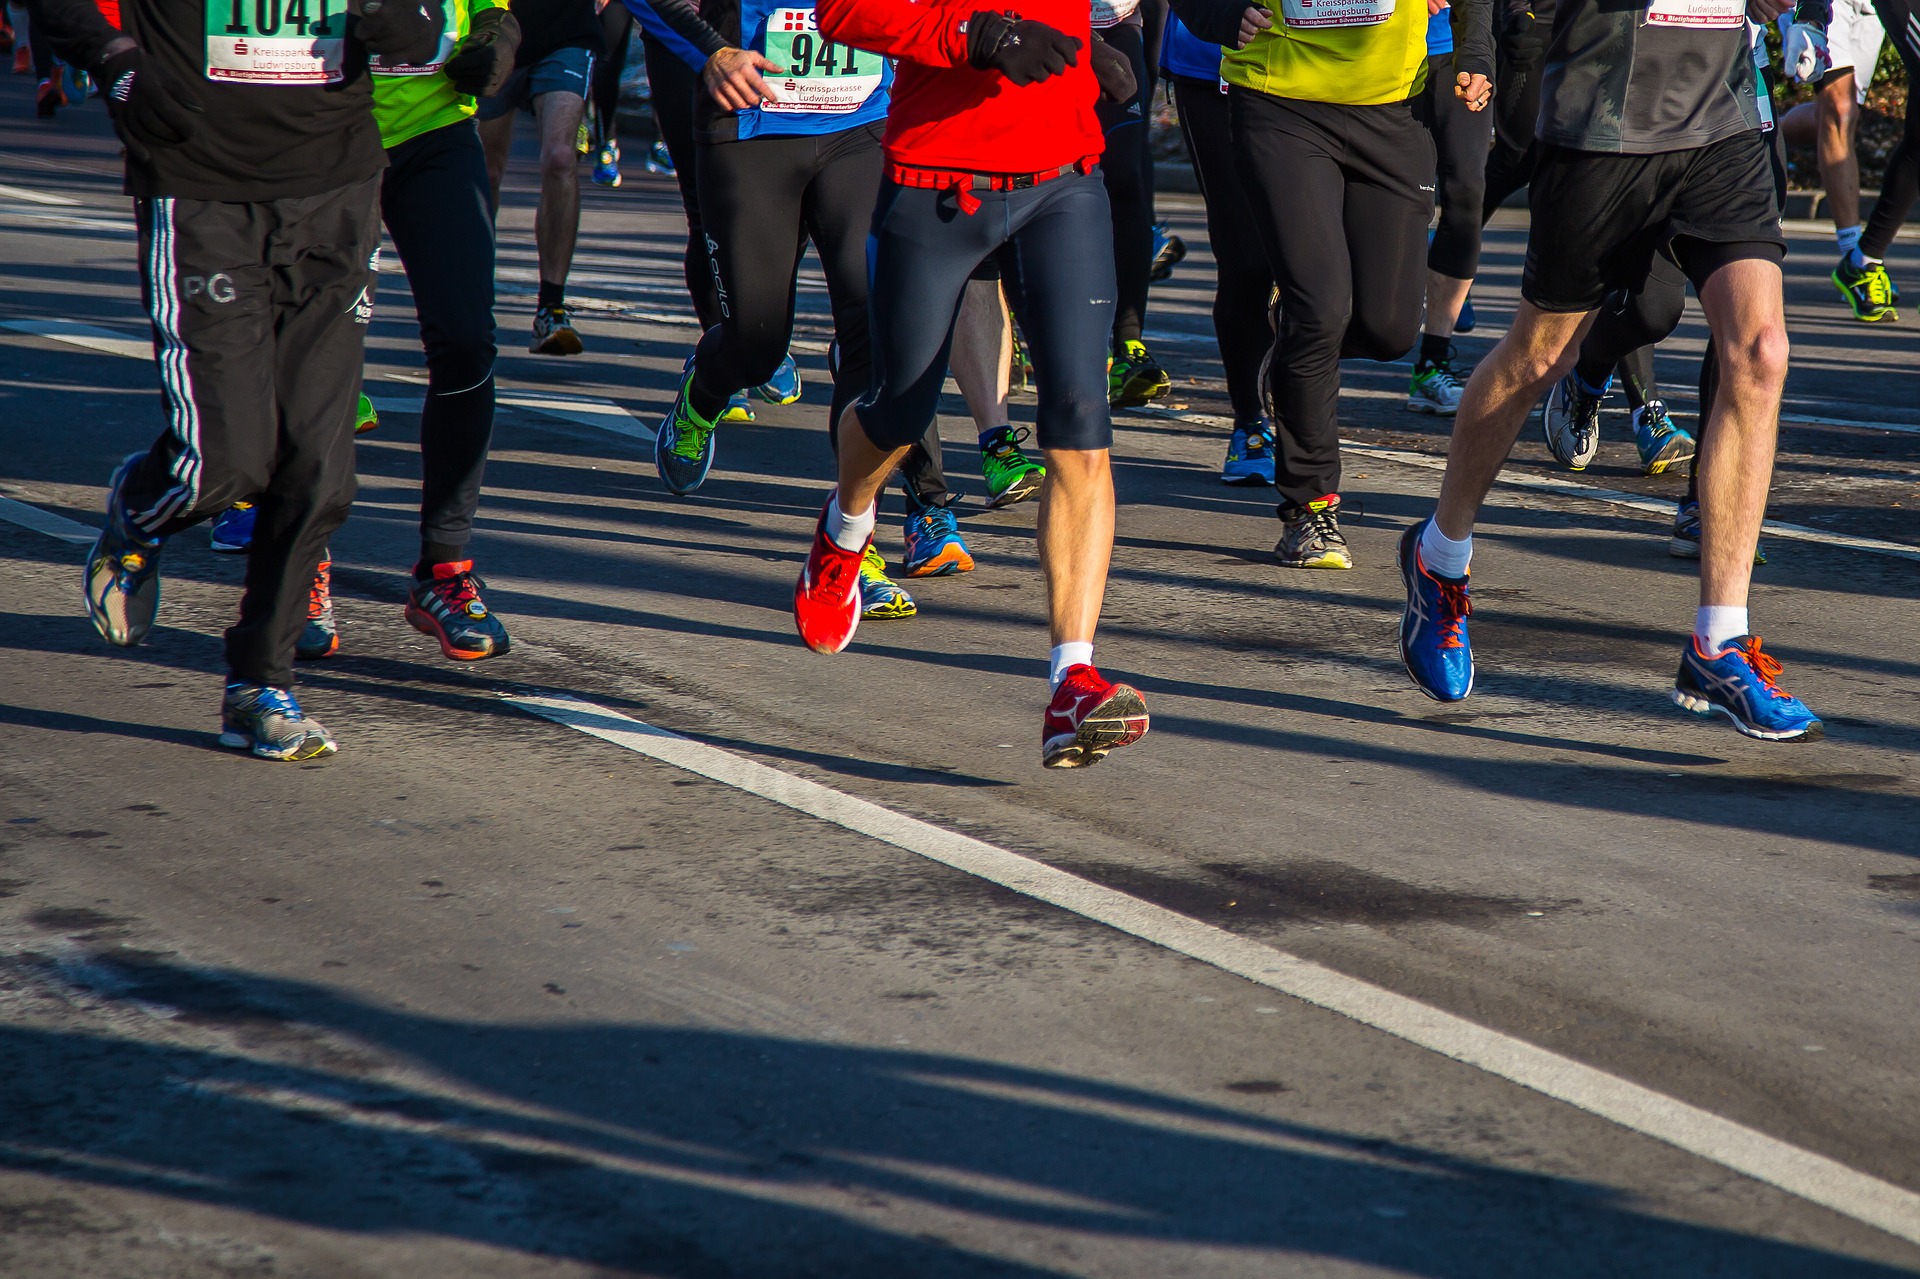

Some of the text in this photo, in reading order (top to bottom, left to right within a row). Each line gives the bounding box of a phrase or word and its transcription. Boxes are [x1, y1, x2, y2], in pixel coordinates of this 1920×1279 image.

[1317, 8, 1370, 17] Ludwigsburg
[1688, 5, 1733, 16] Ludwigsburg
[225, 0, 332, 36] 1041
[1299, 18, 1338, 26] Bietigheimer
[1339, 15, 1377, 24] Silvesterlauf
[253, 47, 325, 57] Kreissparkasse
[791, 33, 858, 76] 941
[253, 60, 316, 71] Ludwigsburg
[800, 85, 862, 94] Kreissparkasse
[799, 94, 854, 104] Ludwigsburg
[183, 273, 236, 303] PG
[711, 258, 730, 318] odlo
